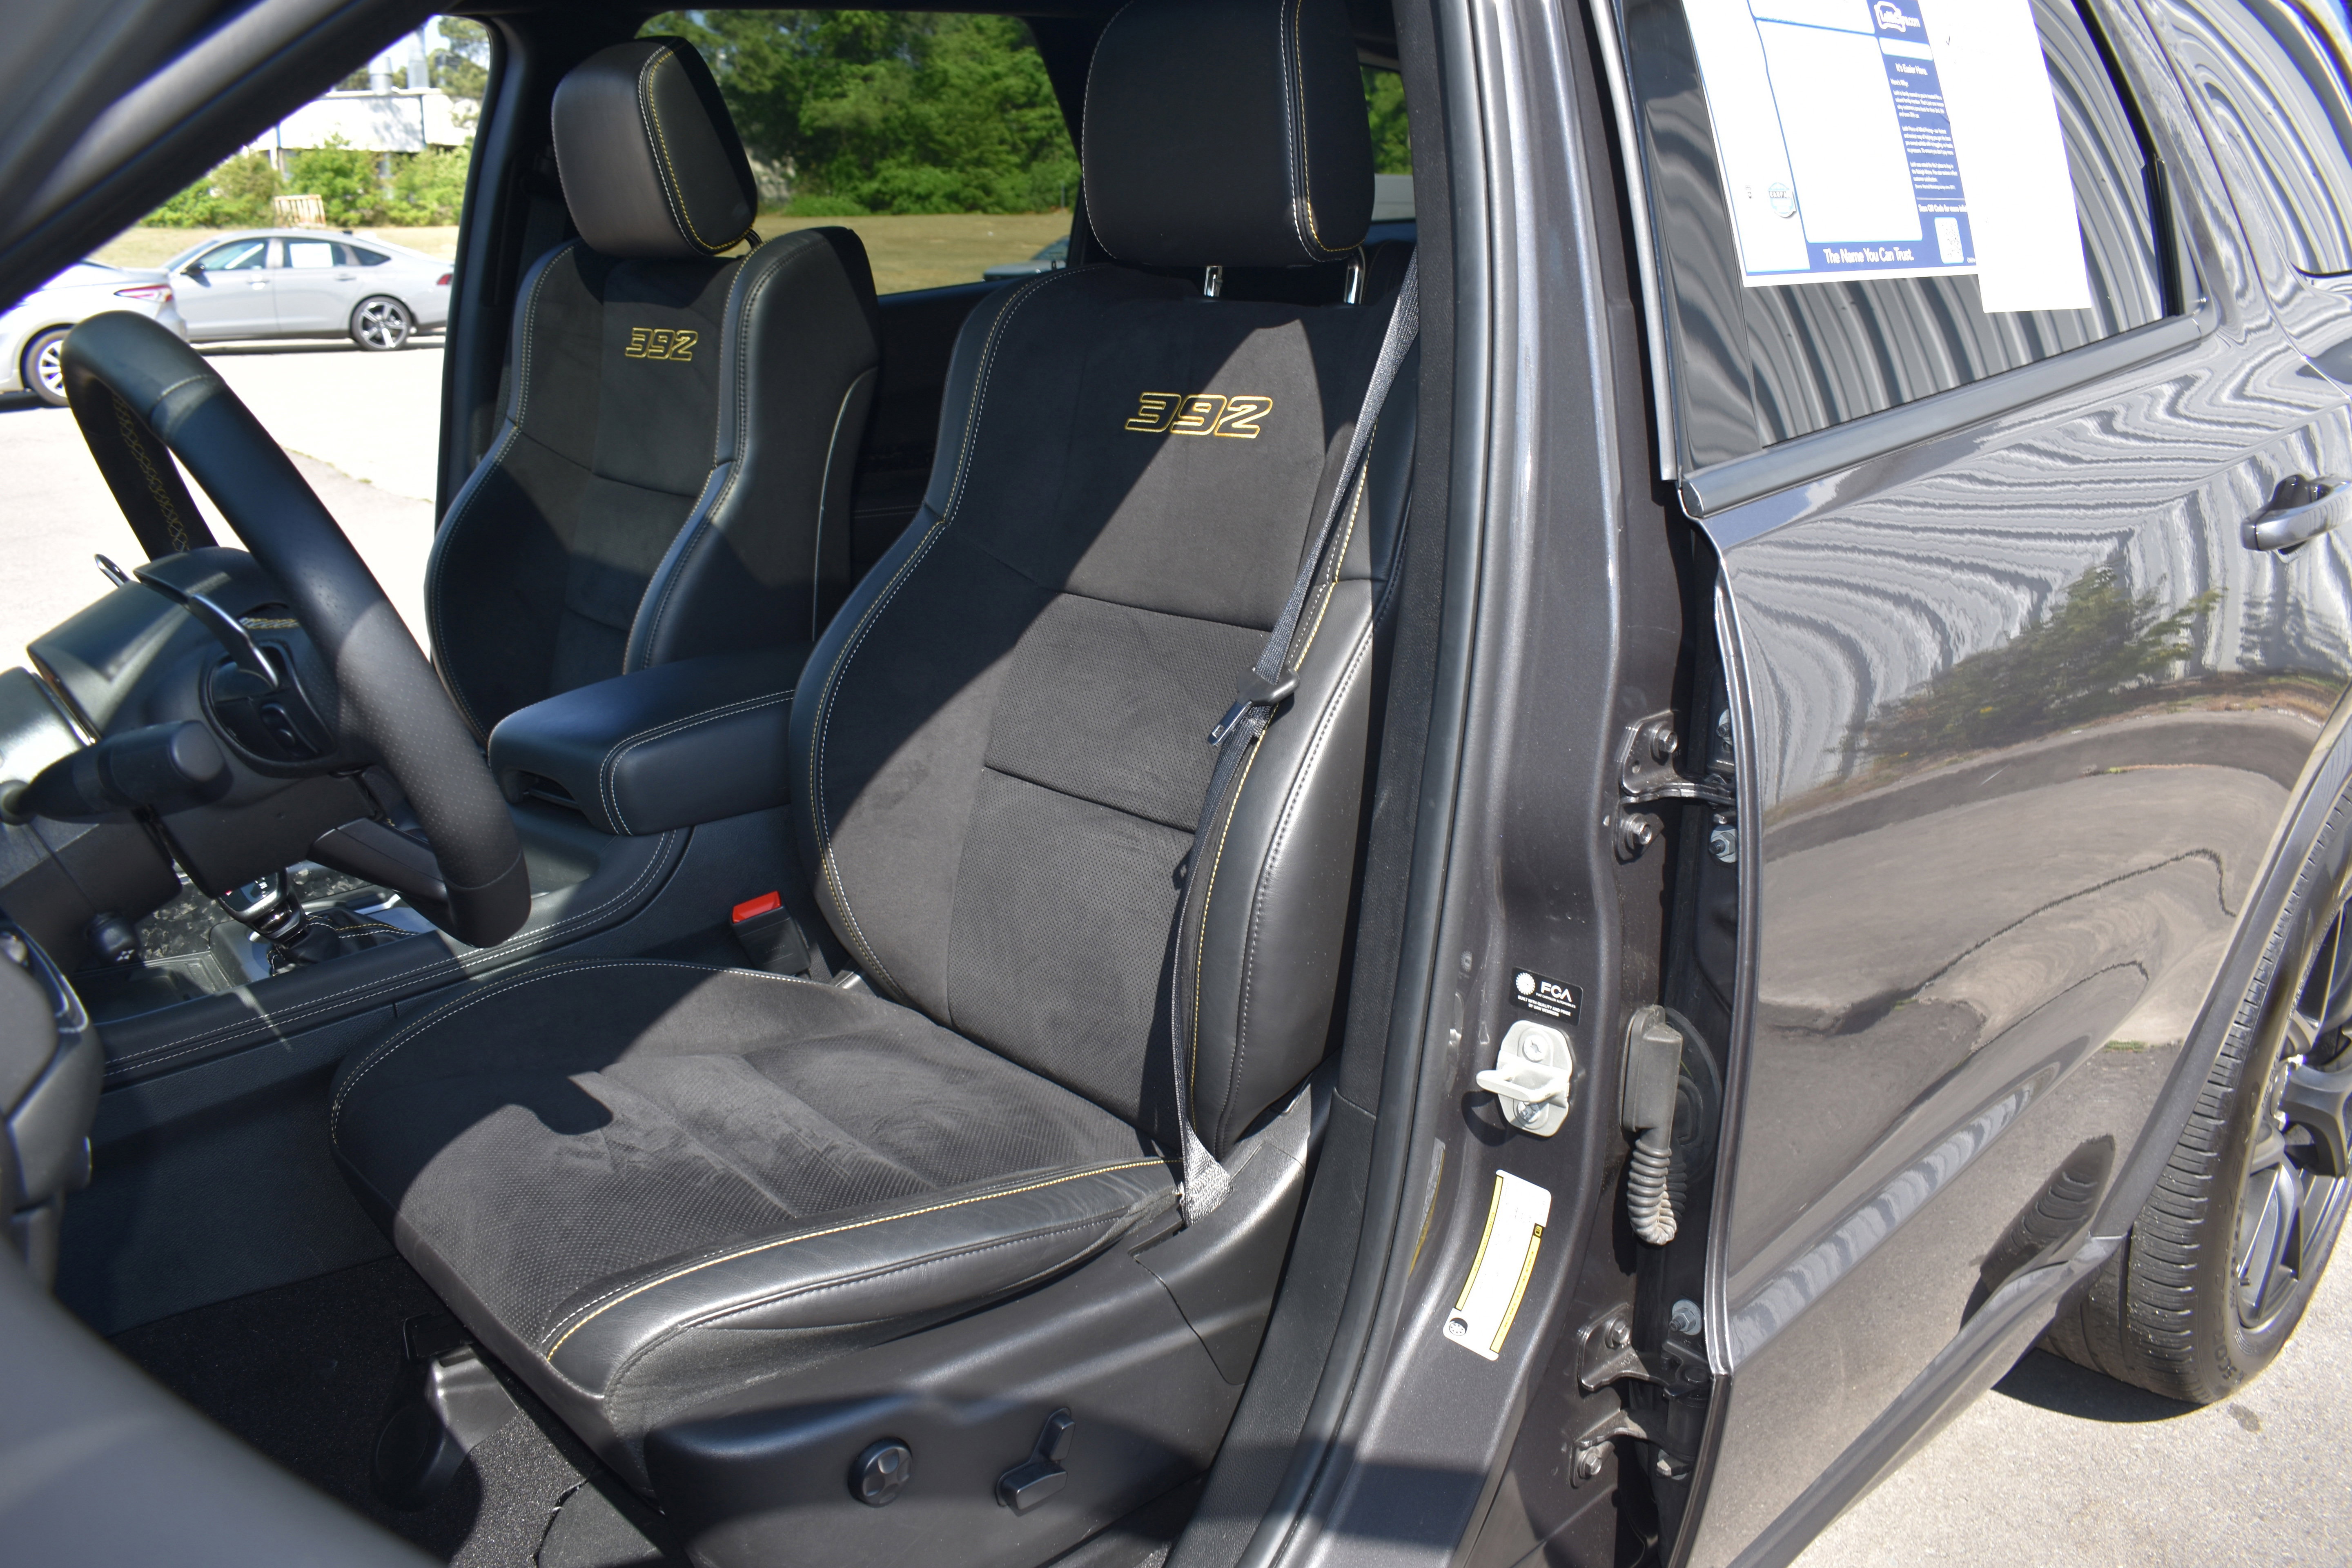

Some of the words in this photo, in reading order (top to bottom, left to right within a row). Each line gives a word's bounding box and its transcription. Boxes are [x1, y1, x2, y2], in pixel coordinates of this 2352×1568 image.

[1823, 248, 1841, 264] The
[1840, 248, 1864, 263] Name
[1863, 247, 1879, 263] You
[1878, 247, 1895, 262] Can
[1893, 246, 1914, 261] Trust.
[625, 327, 698, 361] 392
[1125, 392, 1273, 439] 392
[1541, 981, 1572, 1002] FCA
[1537, 1000, 1552, 1010] QUALITY
